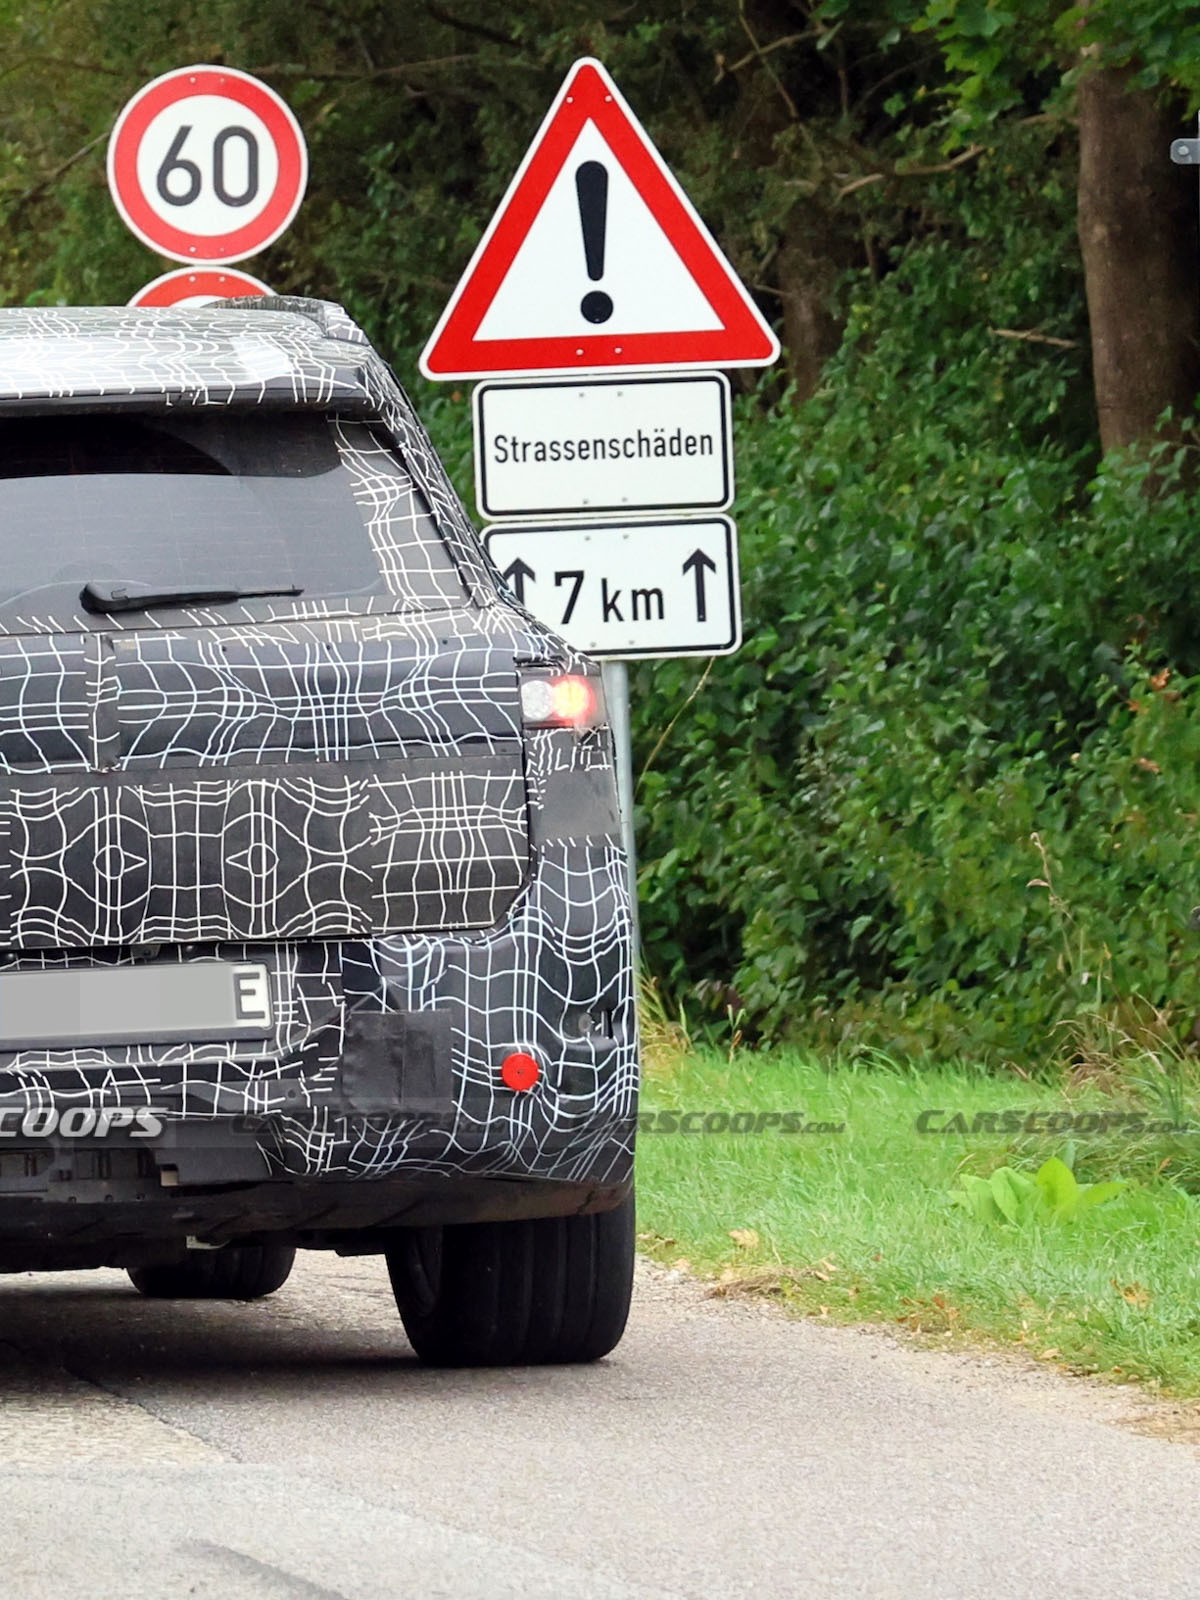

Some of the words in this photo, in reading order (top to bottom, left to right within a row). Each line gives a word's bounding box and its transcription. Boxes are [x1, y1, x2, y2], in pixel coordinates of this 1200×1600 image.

[157, 125, 259, 208] 60
[494, 428, 713, 463] Strassenschäden
[554, 570, 585, 625] 7
[601, 578, 665, 623] km
[233, 972, 266, 1020] E
